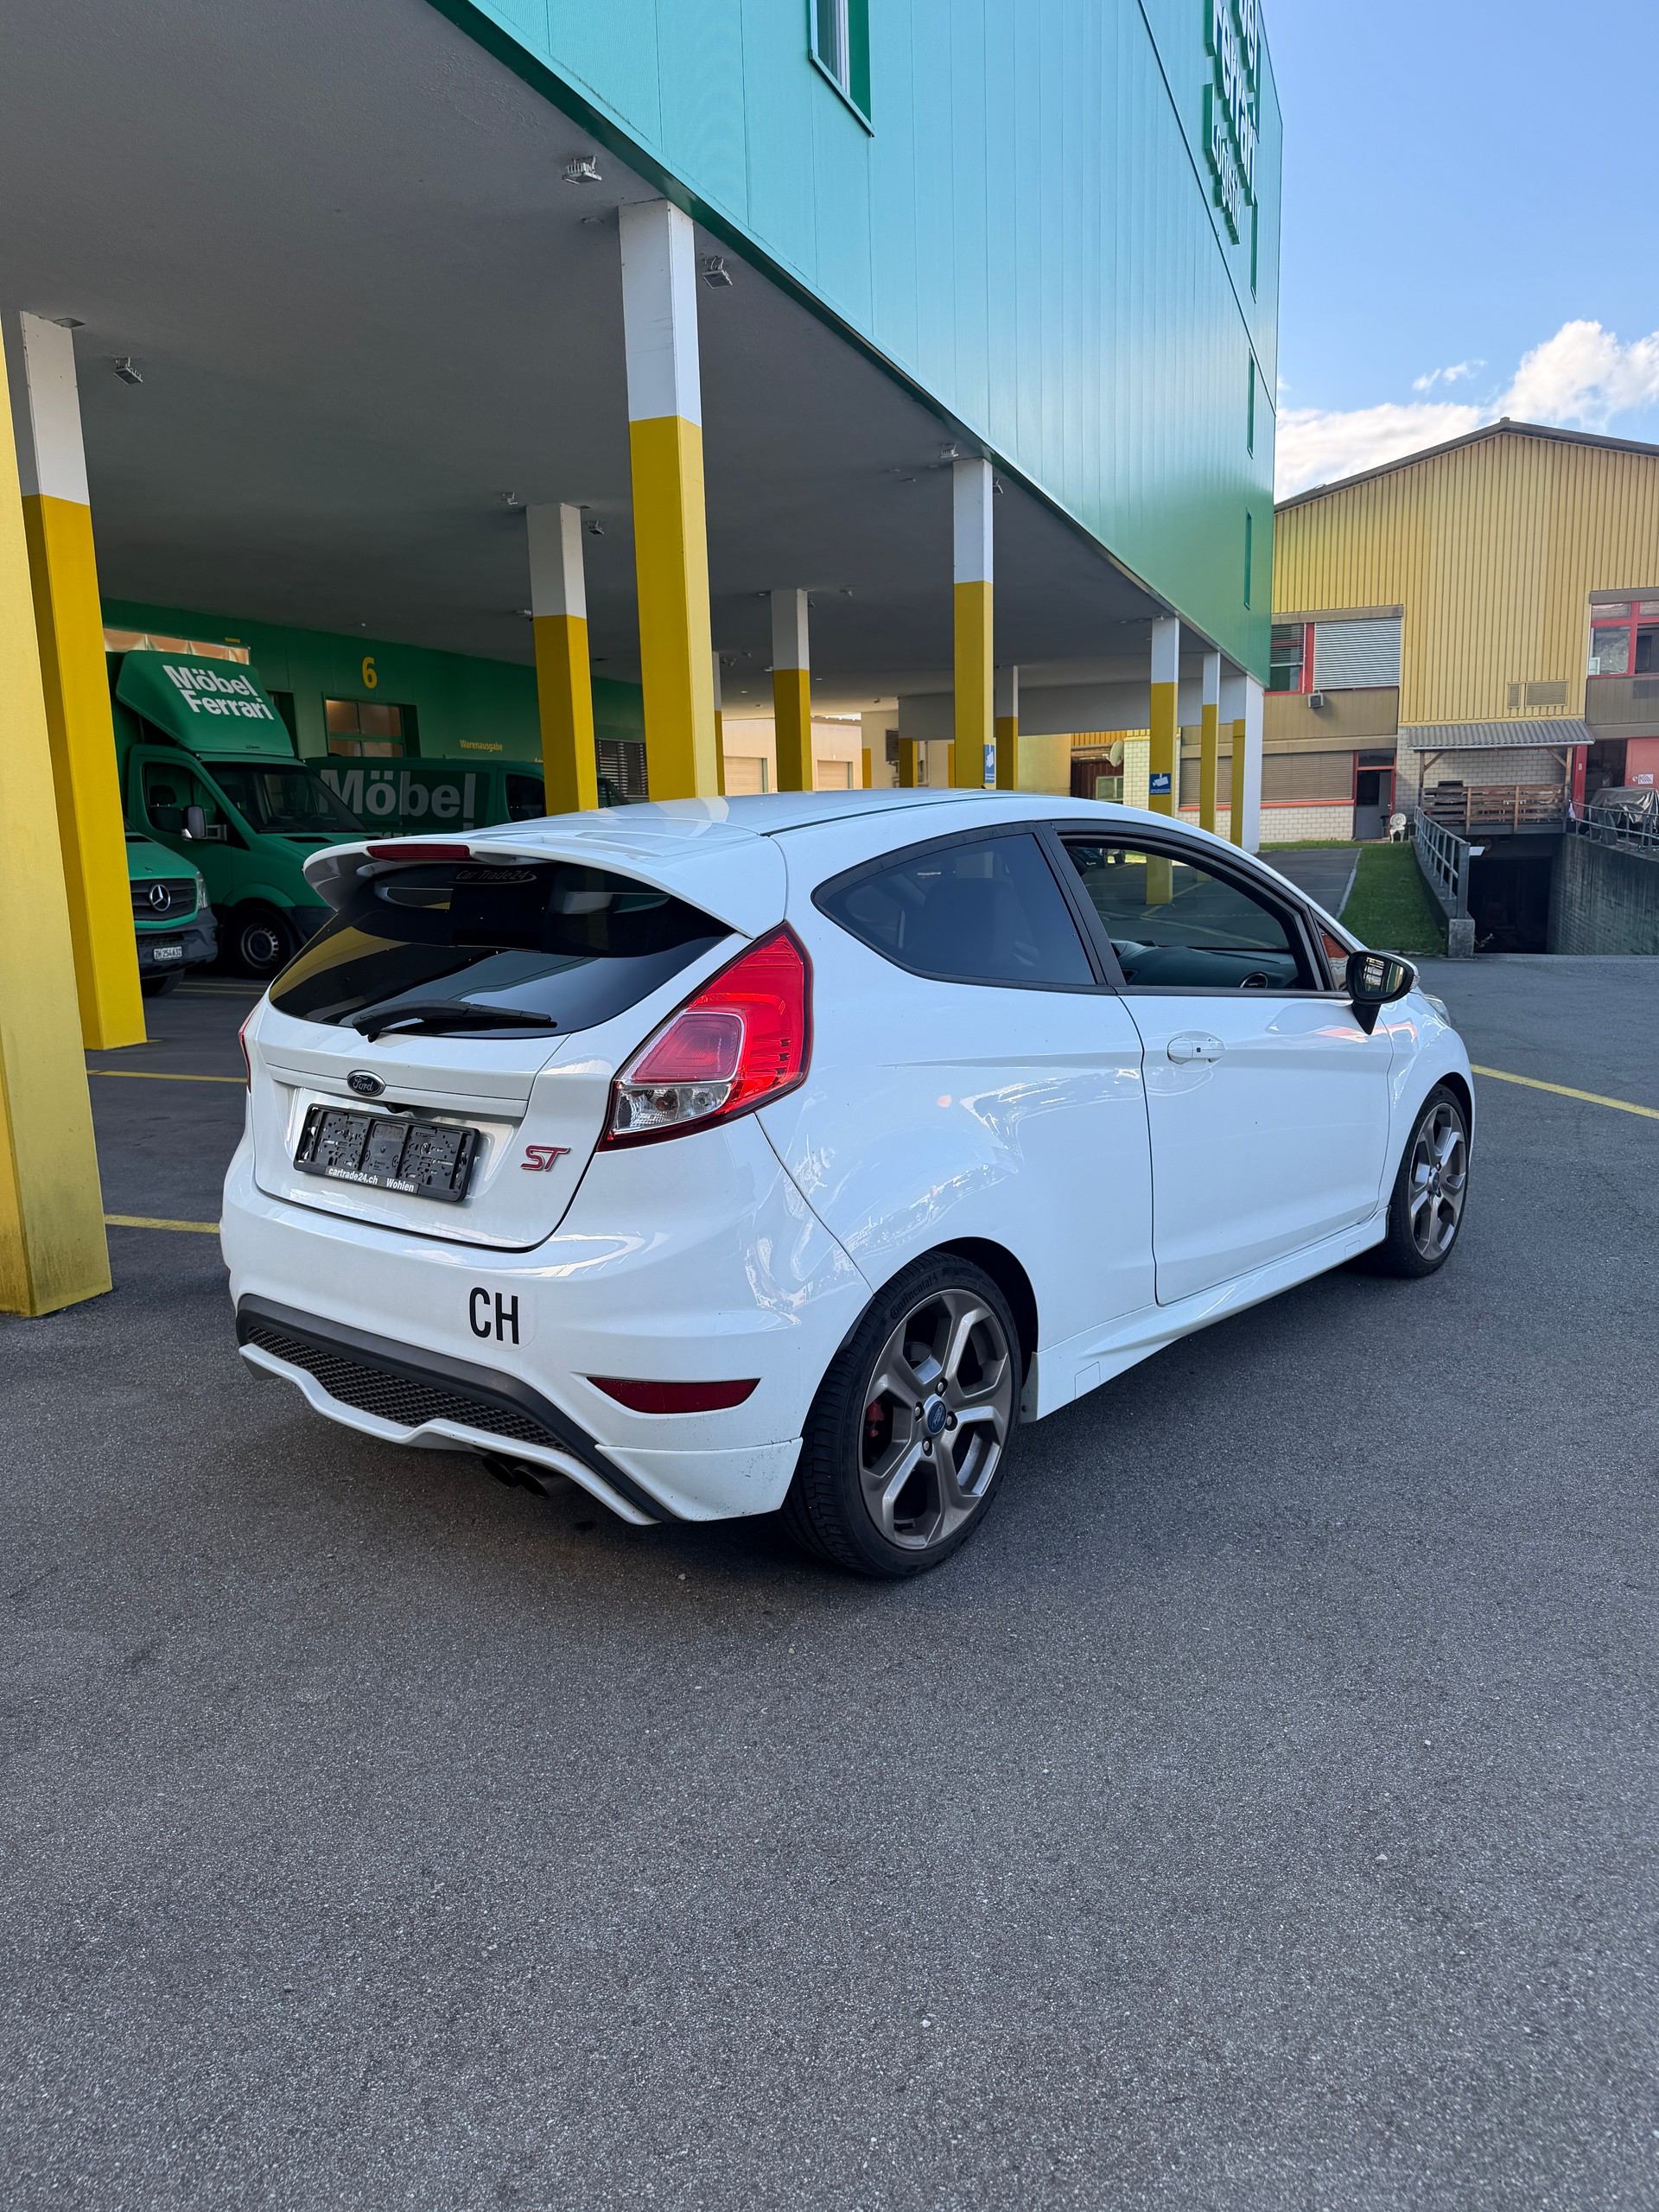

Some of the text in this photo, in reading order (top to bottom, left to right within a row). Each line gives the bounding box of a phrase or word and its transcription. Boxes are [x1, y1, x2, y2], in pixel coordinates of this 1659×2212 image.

[1211, 84, 1242, 244] Logistik
[162, 664, 258, 696] Möbel
[362, 657, 378, 689] 6
[180, 689, 275, 720] Ferrari
[460, 740, 503, 752] Warenausgabe
[320, 769, 476, 818] Möbel
[456, 869, 531, 880] Car Trade24
[352, 1075, 374, 1092] Ford
[520, 1145, 571, 1172] ST
[328, 1167, 415, 1192] cartrade24.ch Wohlen
[890, 1275, 933, 1319] Continental
[469, 1287, 519, 1345] CH
